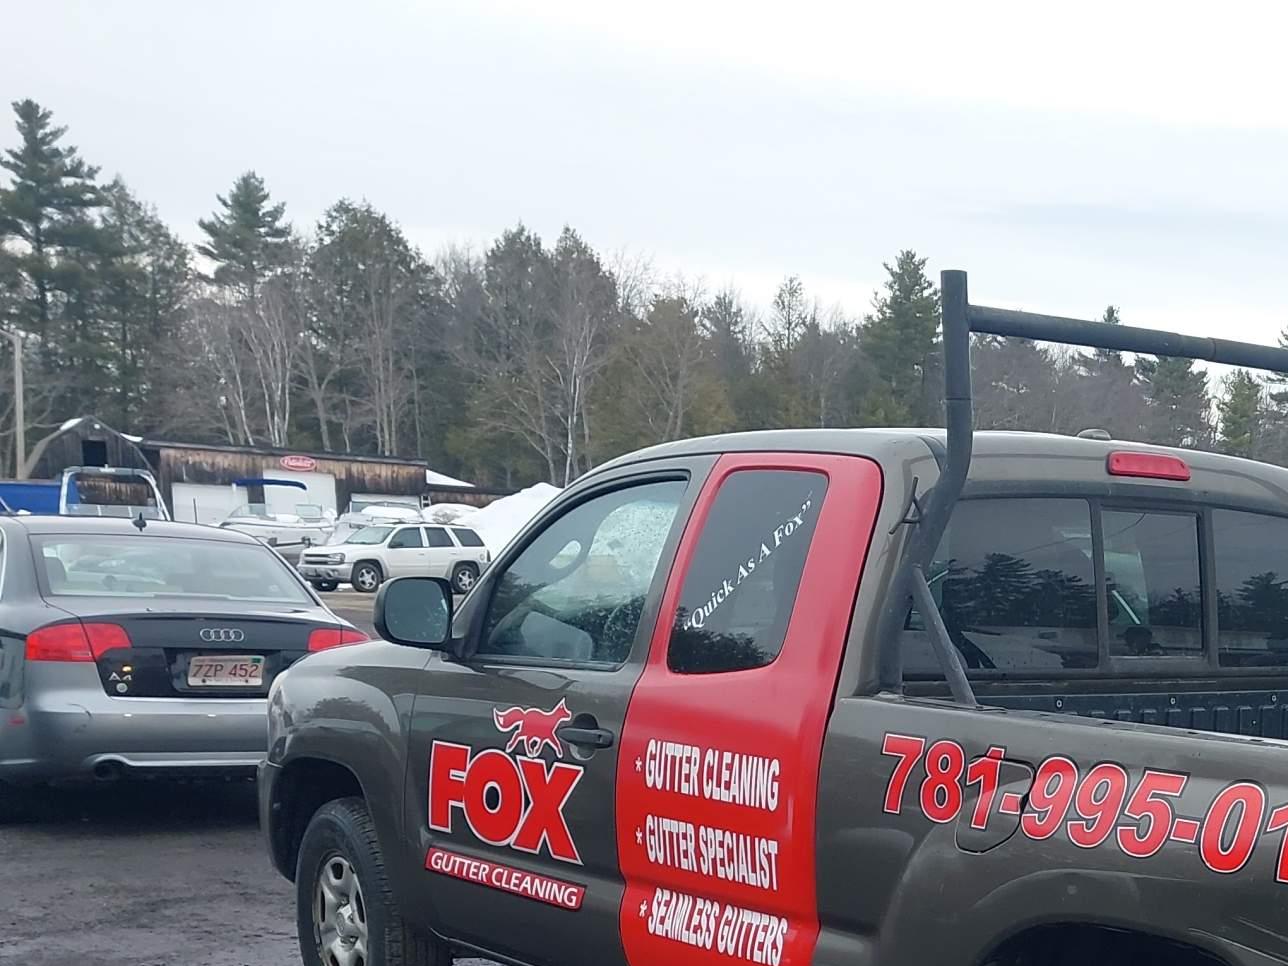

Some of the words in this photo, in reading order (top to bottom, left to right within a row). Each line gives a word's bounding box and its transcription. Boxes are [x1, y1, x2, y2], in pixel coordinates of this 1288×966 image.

[736, 558, 755, 585] As
[758, 543, 772, 563] A
[108, 671, 133, 682] A4
[192, 664, 224, 678] 7ZP
[228, 664, 260, 678] 452
[428, 739, 585, 867] FOX
[644, 738, 701, 797] GUTTER
[702, 747, 781, 812] CLEANING
[430, 851, 489, 884] GUTTER
[491, 866, 578, 908] CLEANING
[645, 814, 698, 873] GUTTER
[699, 825, 779, 891] SPECIALIST
[647, 887, 720, 950] SEAMLESS
